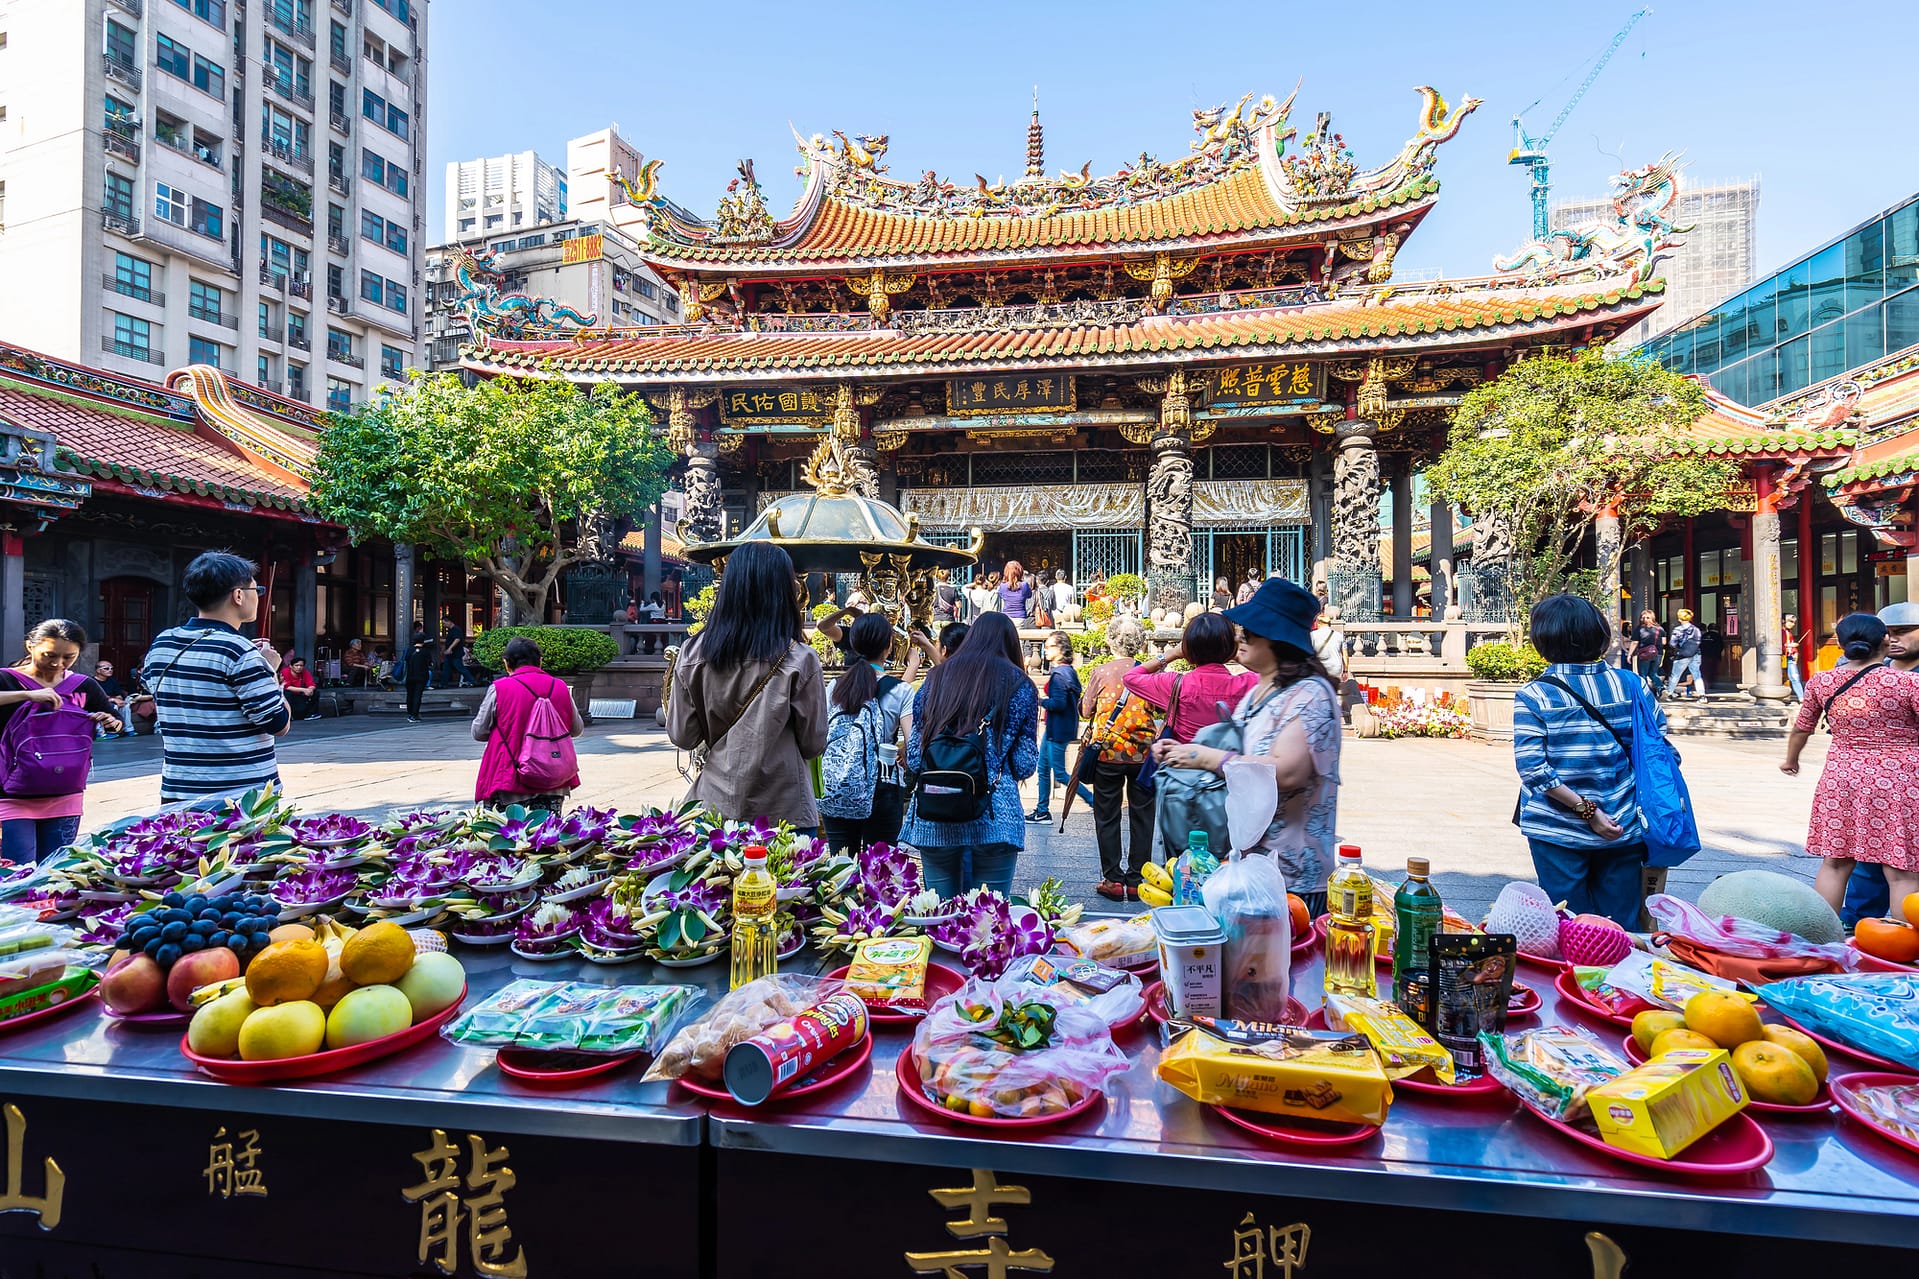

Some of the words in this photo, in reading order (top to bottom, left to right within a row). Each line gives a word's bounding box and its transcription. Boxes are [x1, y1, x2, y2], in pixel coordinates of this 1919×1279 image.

[1187, 964, 1214, 974] 不平凡
[202, 1126, 269, 1199] 艋
[401, 1129, 528, 1279] 龍
